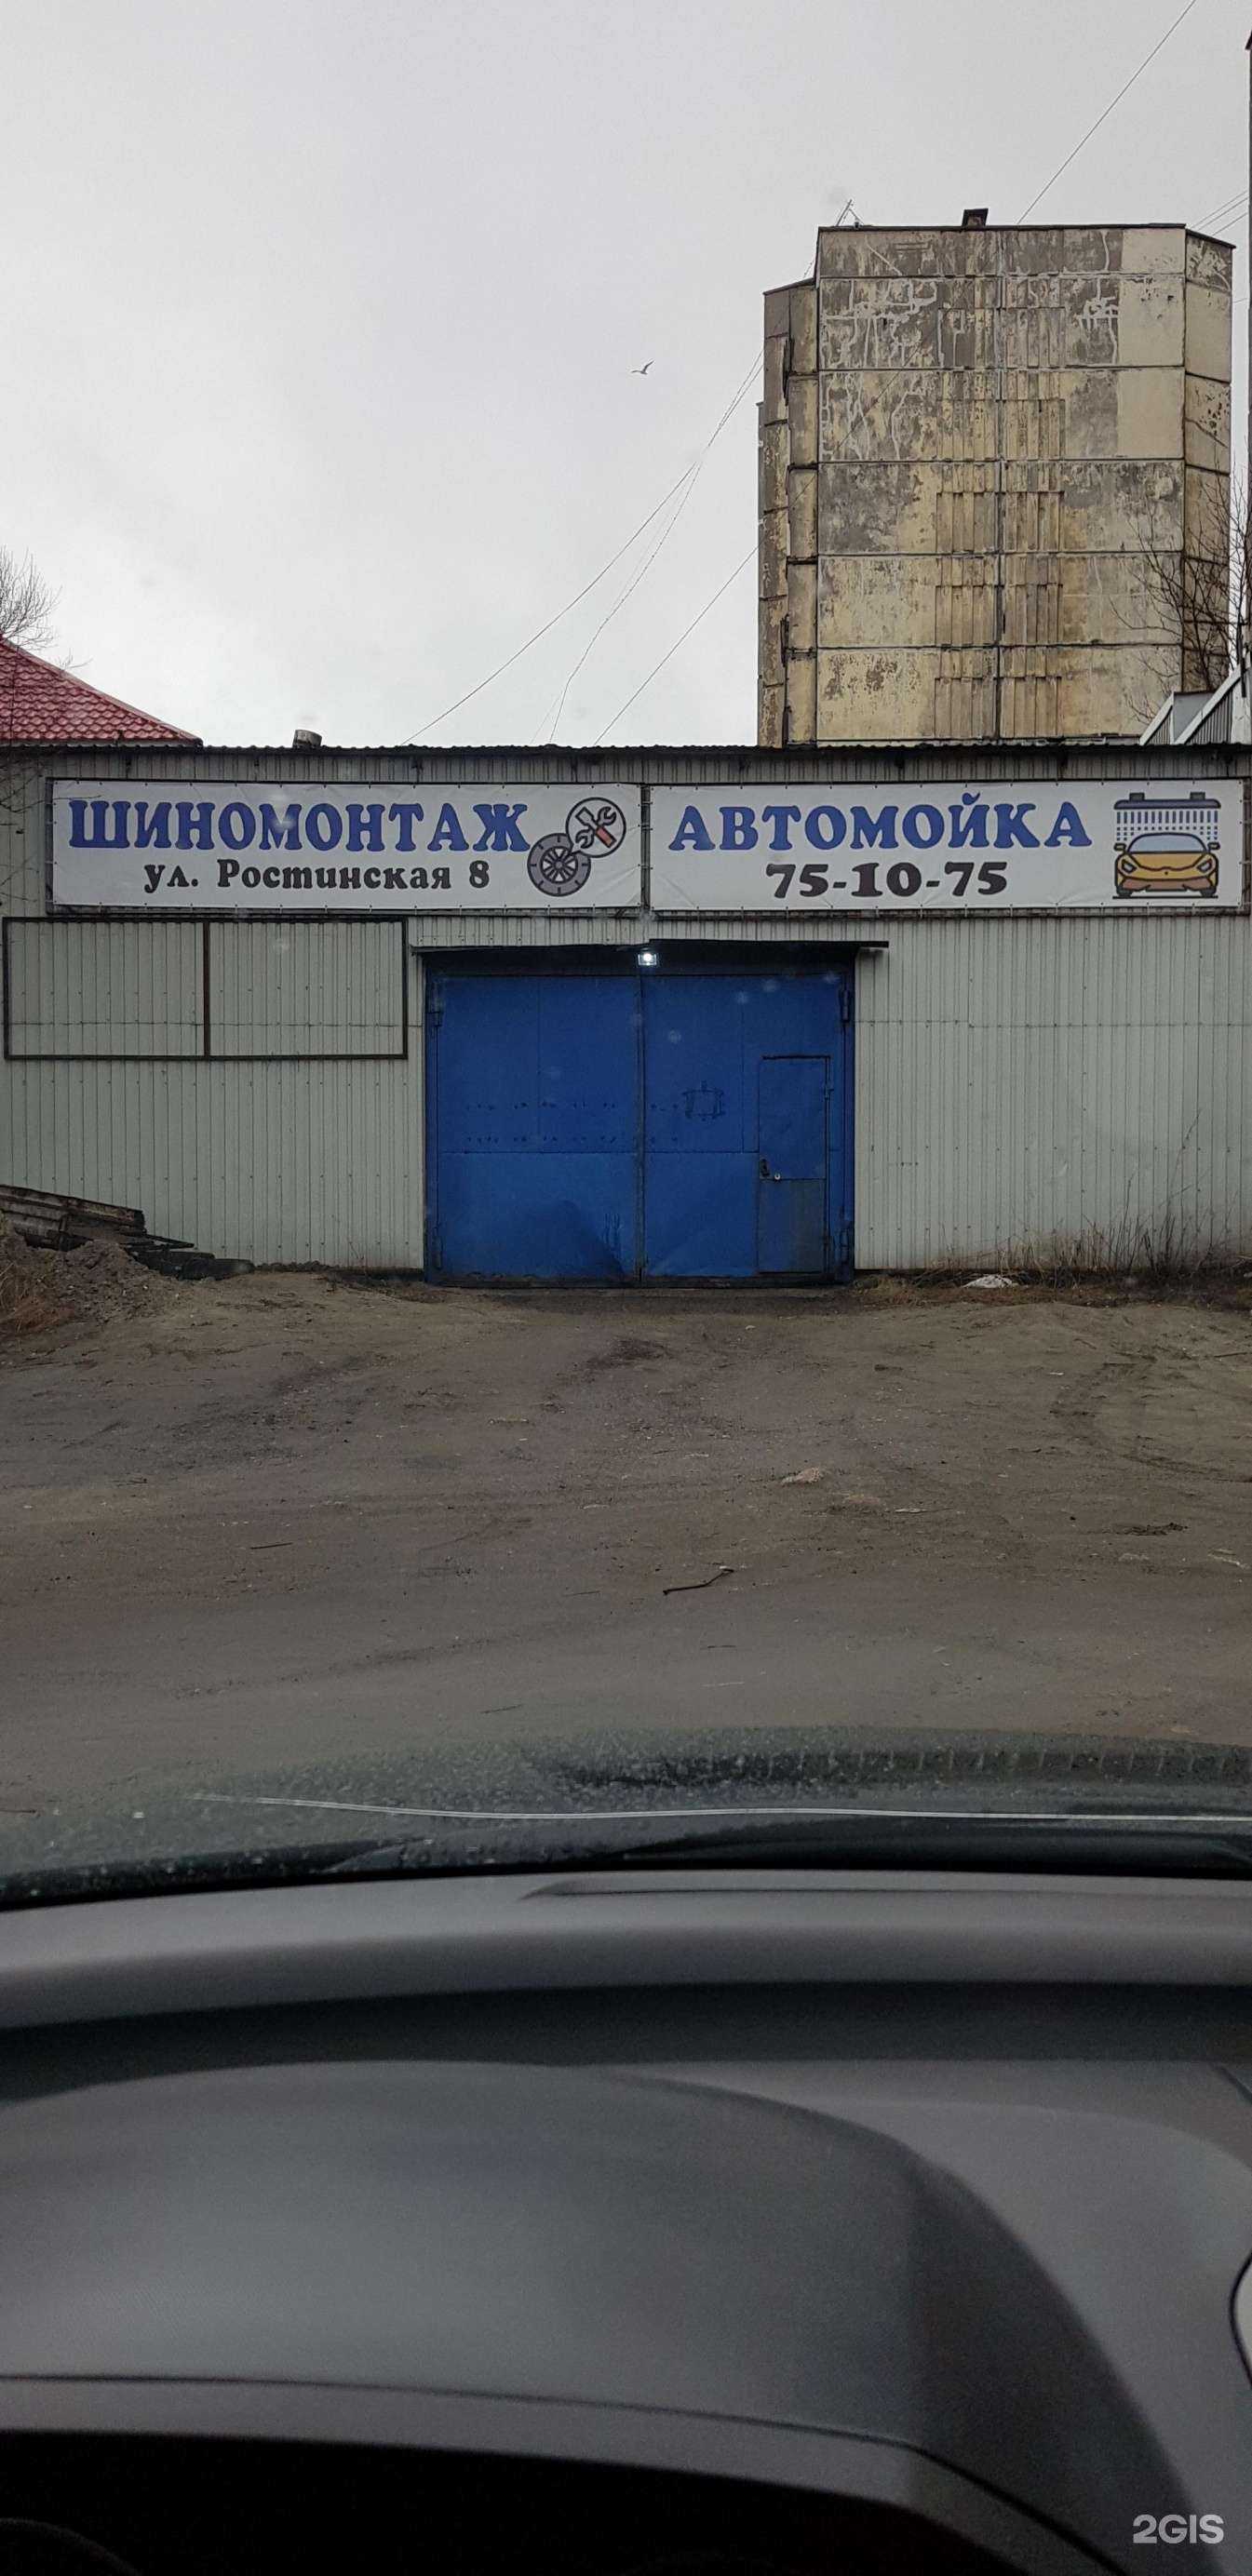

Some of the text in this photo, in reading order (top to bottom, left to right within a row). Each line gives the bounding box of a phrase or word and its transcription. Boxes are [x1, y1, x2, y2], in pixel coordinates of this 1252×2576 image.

[68, 799, 531, 852] ШИНОМОНТАЖ
[668, 792, 1092, 851] АВТОМОЙКА
[143, 859, 490, 893] ул. Ростинская 8
[766, 862, 1008, 898] 75-10-75
